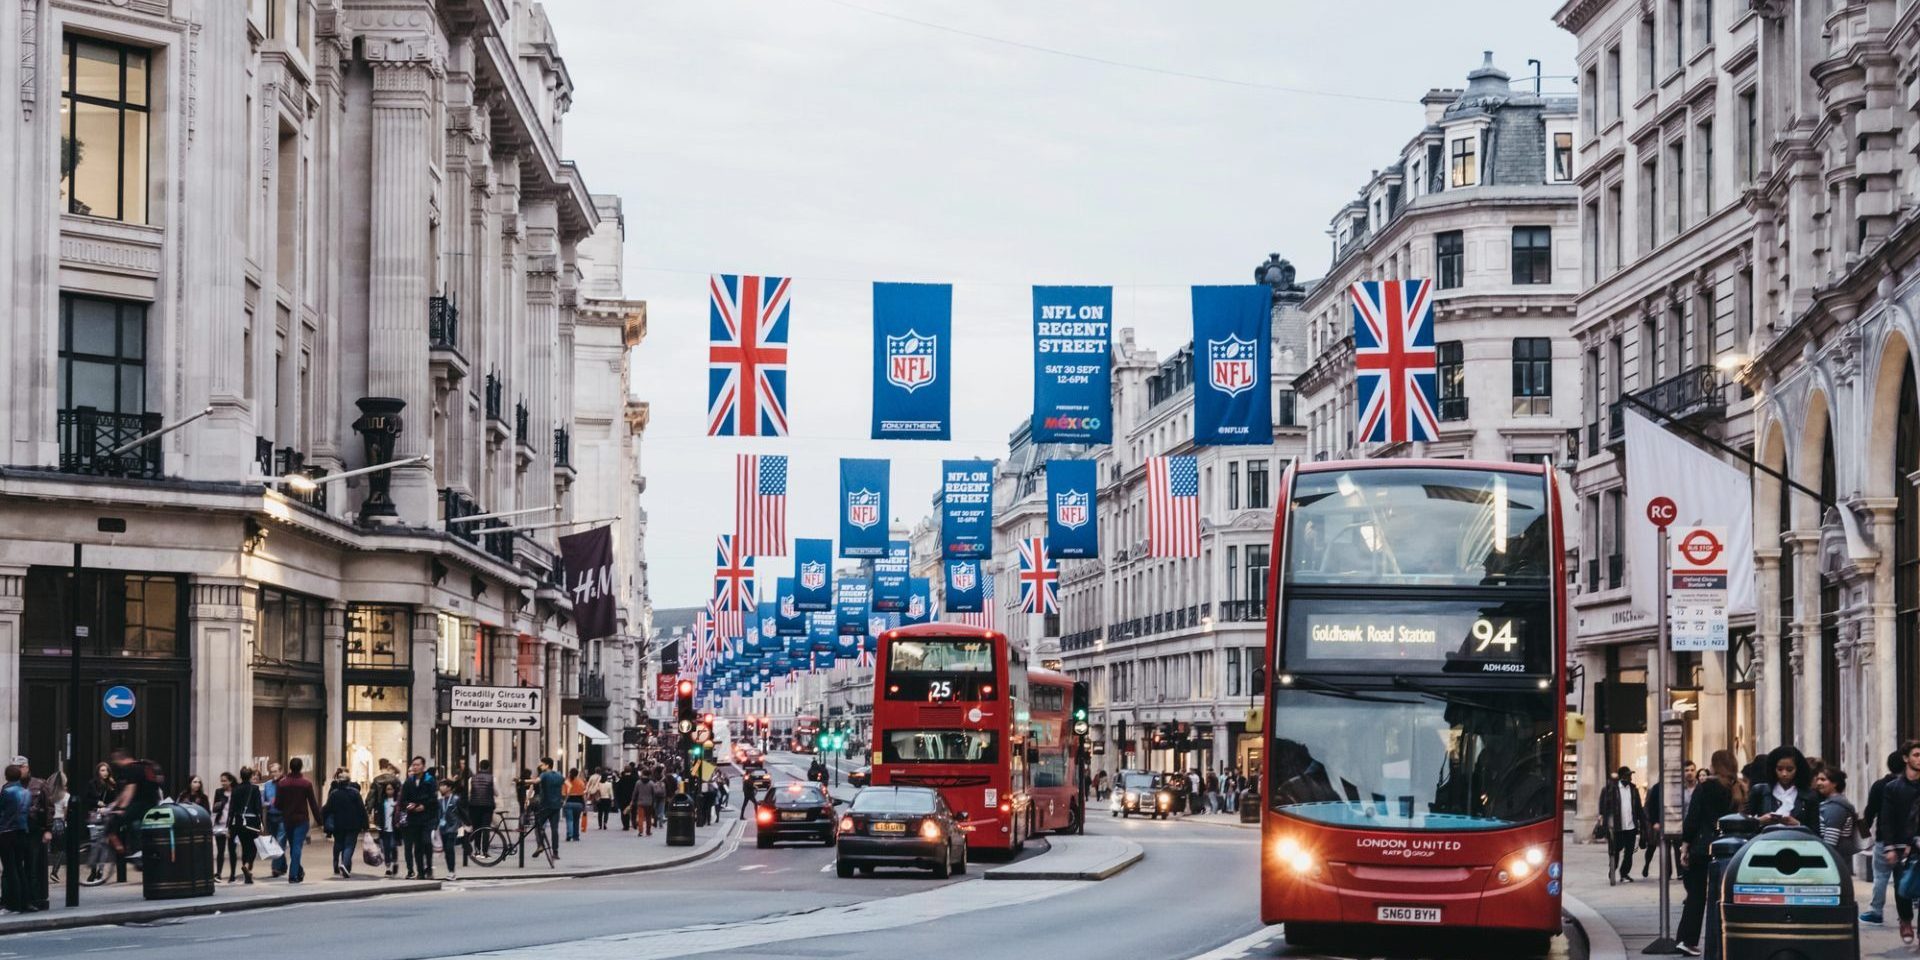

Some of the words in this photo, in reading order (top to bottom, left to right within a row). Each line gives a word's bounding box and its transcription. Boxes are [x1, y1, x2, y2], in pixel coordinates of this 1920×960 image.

[1042, 306, 1076, 319] NFL
[1079, 306, 1104, 319] ON
[1038, 322, 1108, 336] REGENT
[1039, 339, 1107, 353] STREET
[894, 357, 930, 382] NFL
[1045, 365, 1063, 374] SAT
[1064, 365, 1076, 374] 30
[1077, 365, 1100, 374] SEPT
[1216, 362, 1251, 387] NFL
[1057, 375, 1088, 384] 12-6PM
[1218, 426, 1249, 434] @NFLUK
[948, 472, 969, 482] NFL
[971, 472, 988, 482] ON
[945, 483, 990, 493] REGENT
[945, 494, 989, 503] STREET
[853, 506, 876, 523] NFL
[1061, 507, 1084, 523] NFL
[1651, 505, 1672, 518] RC
[875, 564, 908, 572] STREET
[572, 564, 614, 605] H&M
[805, 574, 822, 586] NFL
[955, 576, 972, 588] NFL
[1312, 625, 1363, 642] Goldhawk
[1367, 625, 1394, 642] Road
[1399, 625, 1436, 643] Station
[1472, 619, 1517, 652] 94
[454, 690, 495, 699] Piccadilly
[497, 690, 525, 698] Circus
[931, 681, 950, 697] 25
[455, 699, 493, 709] Trafalgar
[496, 700, 526, 709] Square
[464, 715, 493, 724] Marble
[497, 716, 517, 724] Arch
[1357, 838, 1407, 848] LONDON
[1412, 840, 1461, 850] UNITED
[1382, 908, 1411, 919] SN60
[1414, 909, 1436, 920] BYH
